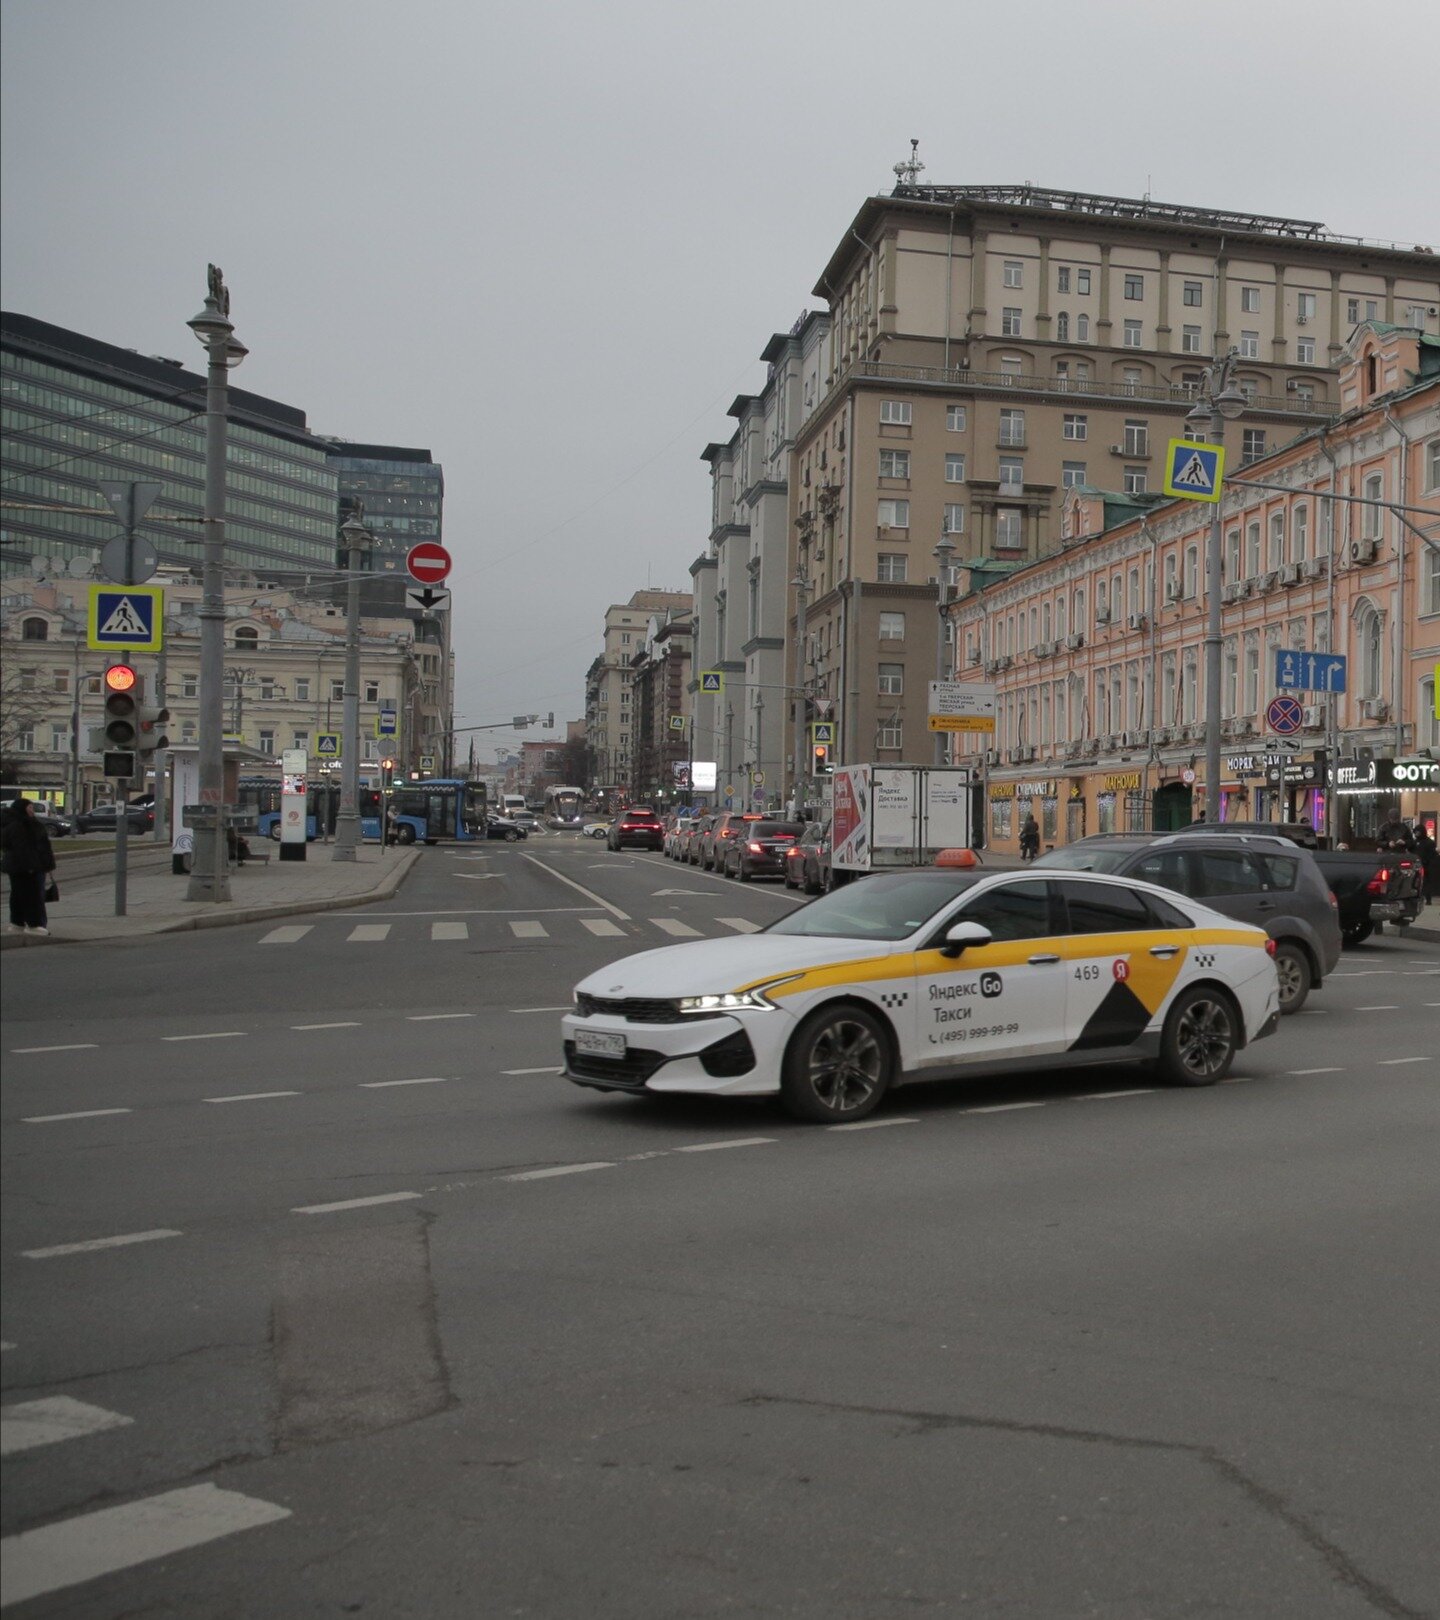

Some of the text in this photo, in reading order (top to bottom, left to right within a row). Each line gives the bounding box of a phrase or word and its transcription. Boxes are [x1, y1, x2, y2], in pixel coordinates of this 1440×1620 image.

[1226, 756, 1254, 771] МОРЯК
[1337, 766, 1358, 784] OFFEE
[1073, 964, 1101, 982] 469
[928, 976, 1001, 1002] Яндекс Go
[933, 1006, 972, 1024] Такси
[938, 1022, 1020, 1045] (495) 999-99-99
